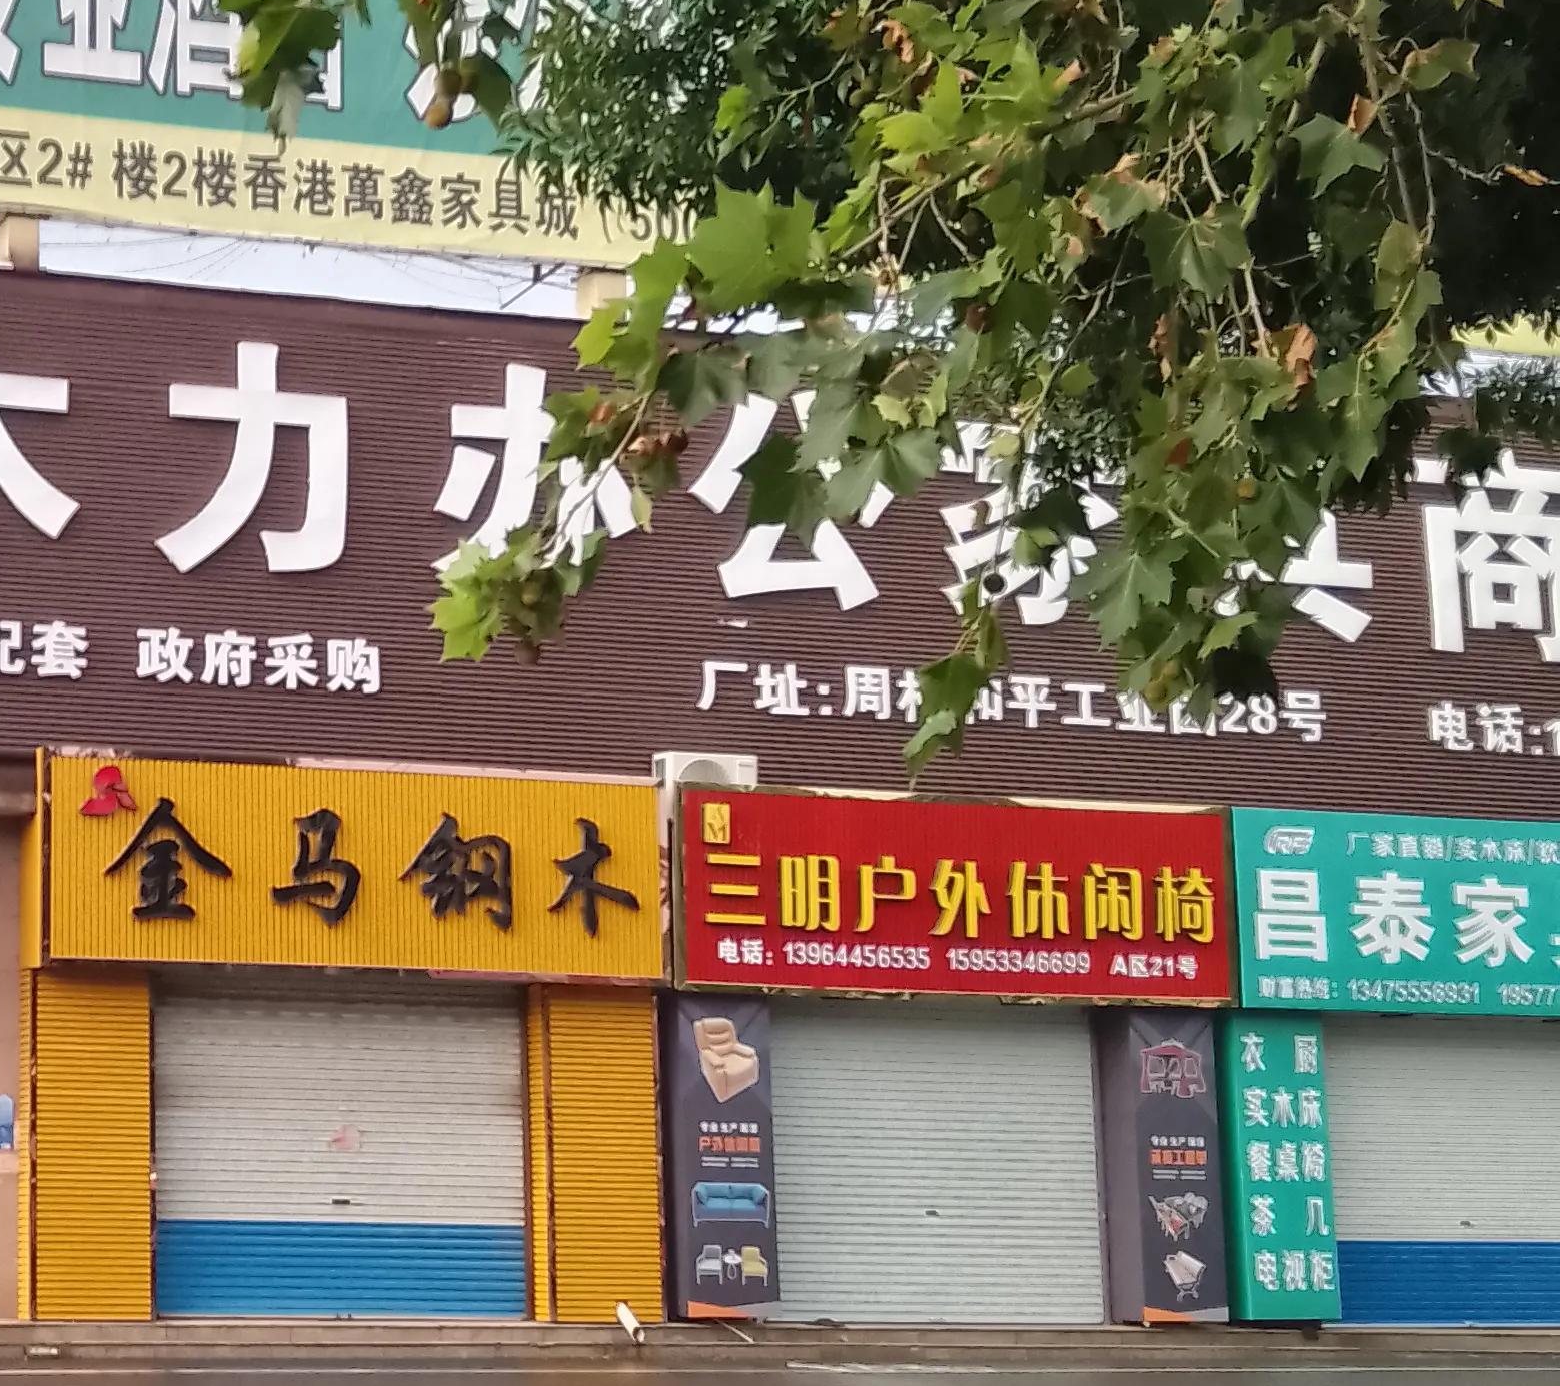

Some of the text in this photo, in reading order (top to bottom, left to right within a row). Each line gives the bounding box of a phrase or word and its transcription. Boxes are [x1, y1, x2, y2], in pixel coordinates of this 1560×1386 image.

[136, 626, 383, 693] 政府采购
[703, 852, 1216, 943] 三明户外休闲椅
[1253, 867, 1560, 967] 昌泰家
[946, 947, 1091, 975] 15953346699
